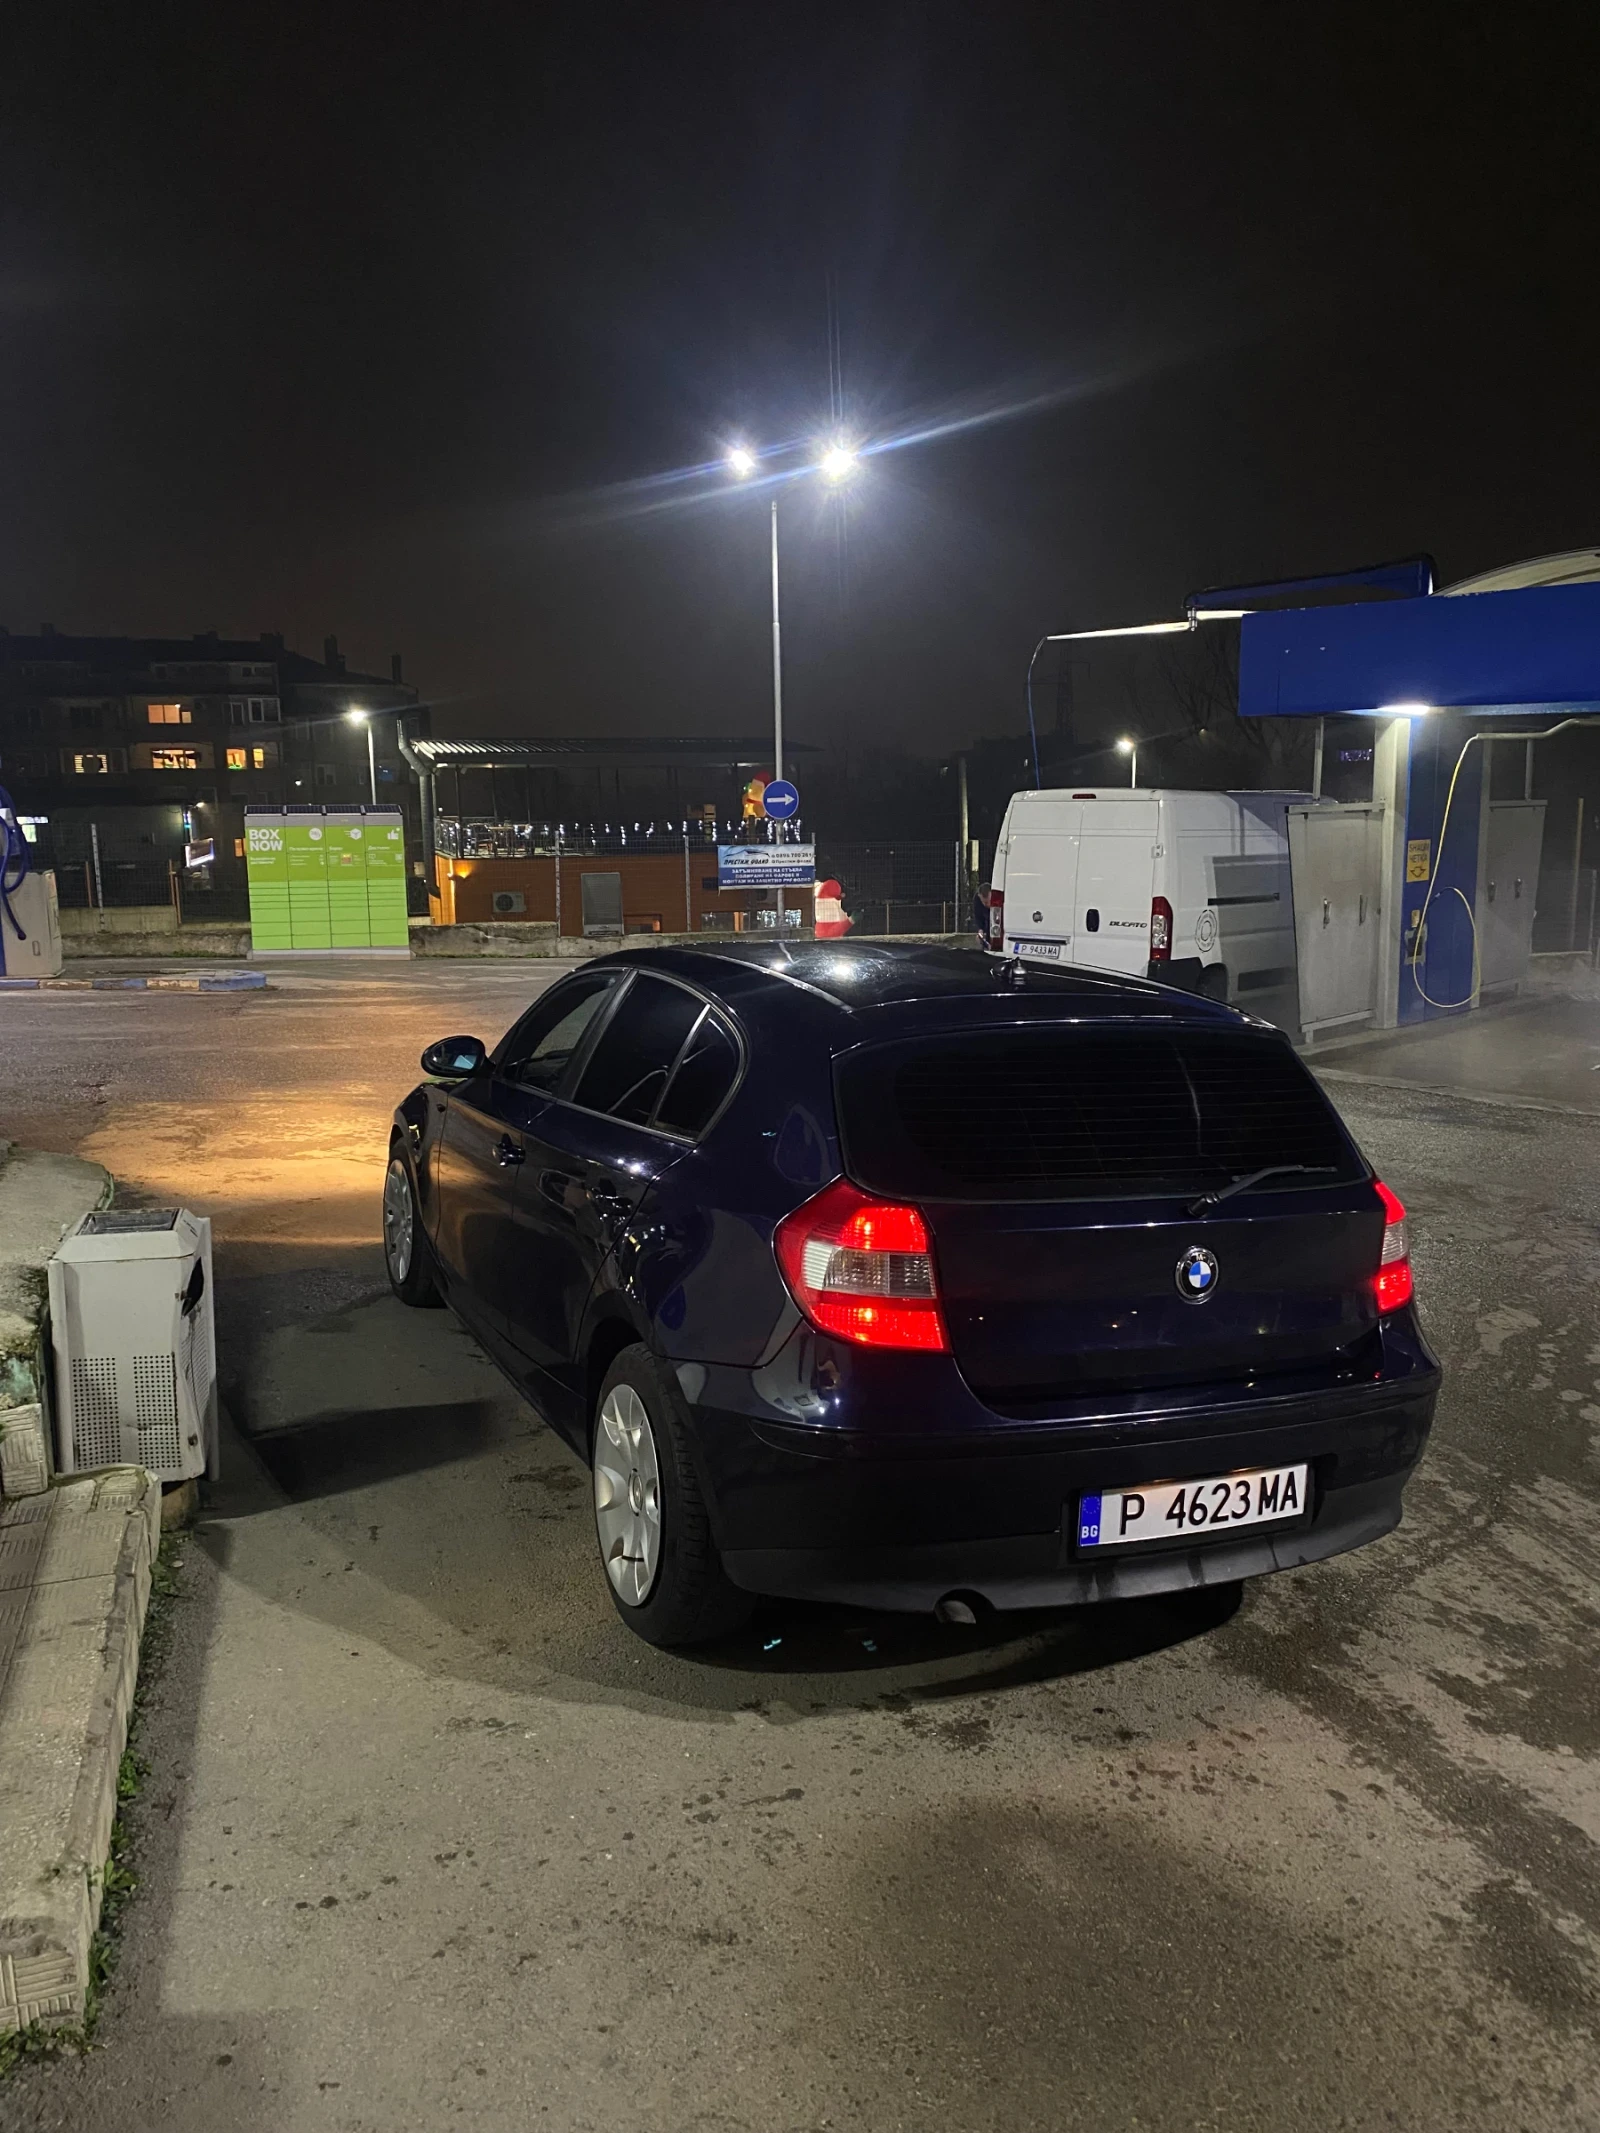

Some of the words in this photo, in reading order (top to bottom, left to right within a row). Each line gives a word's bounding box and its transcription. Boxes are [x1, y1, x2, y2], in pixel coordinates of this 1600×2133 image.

[249, 828, 280, 840] BOX
[250, 840, 283, 851] NOW
[1109, 920, 1148, 928] DUCATO
[1021, 944, 1027, 953] P
[1029, 945, 1047, 955] 9433
[1047, 946, 1057, 956] MA
[1119, 1493, 1145, 1536] P
[1165, 1480, 1251, 1529] 4623
[1257, 1471, 1298, 1516] MA
[1081, 1525, 1098, 1539] BG
